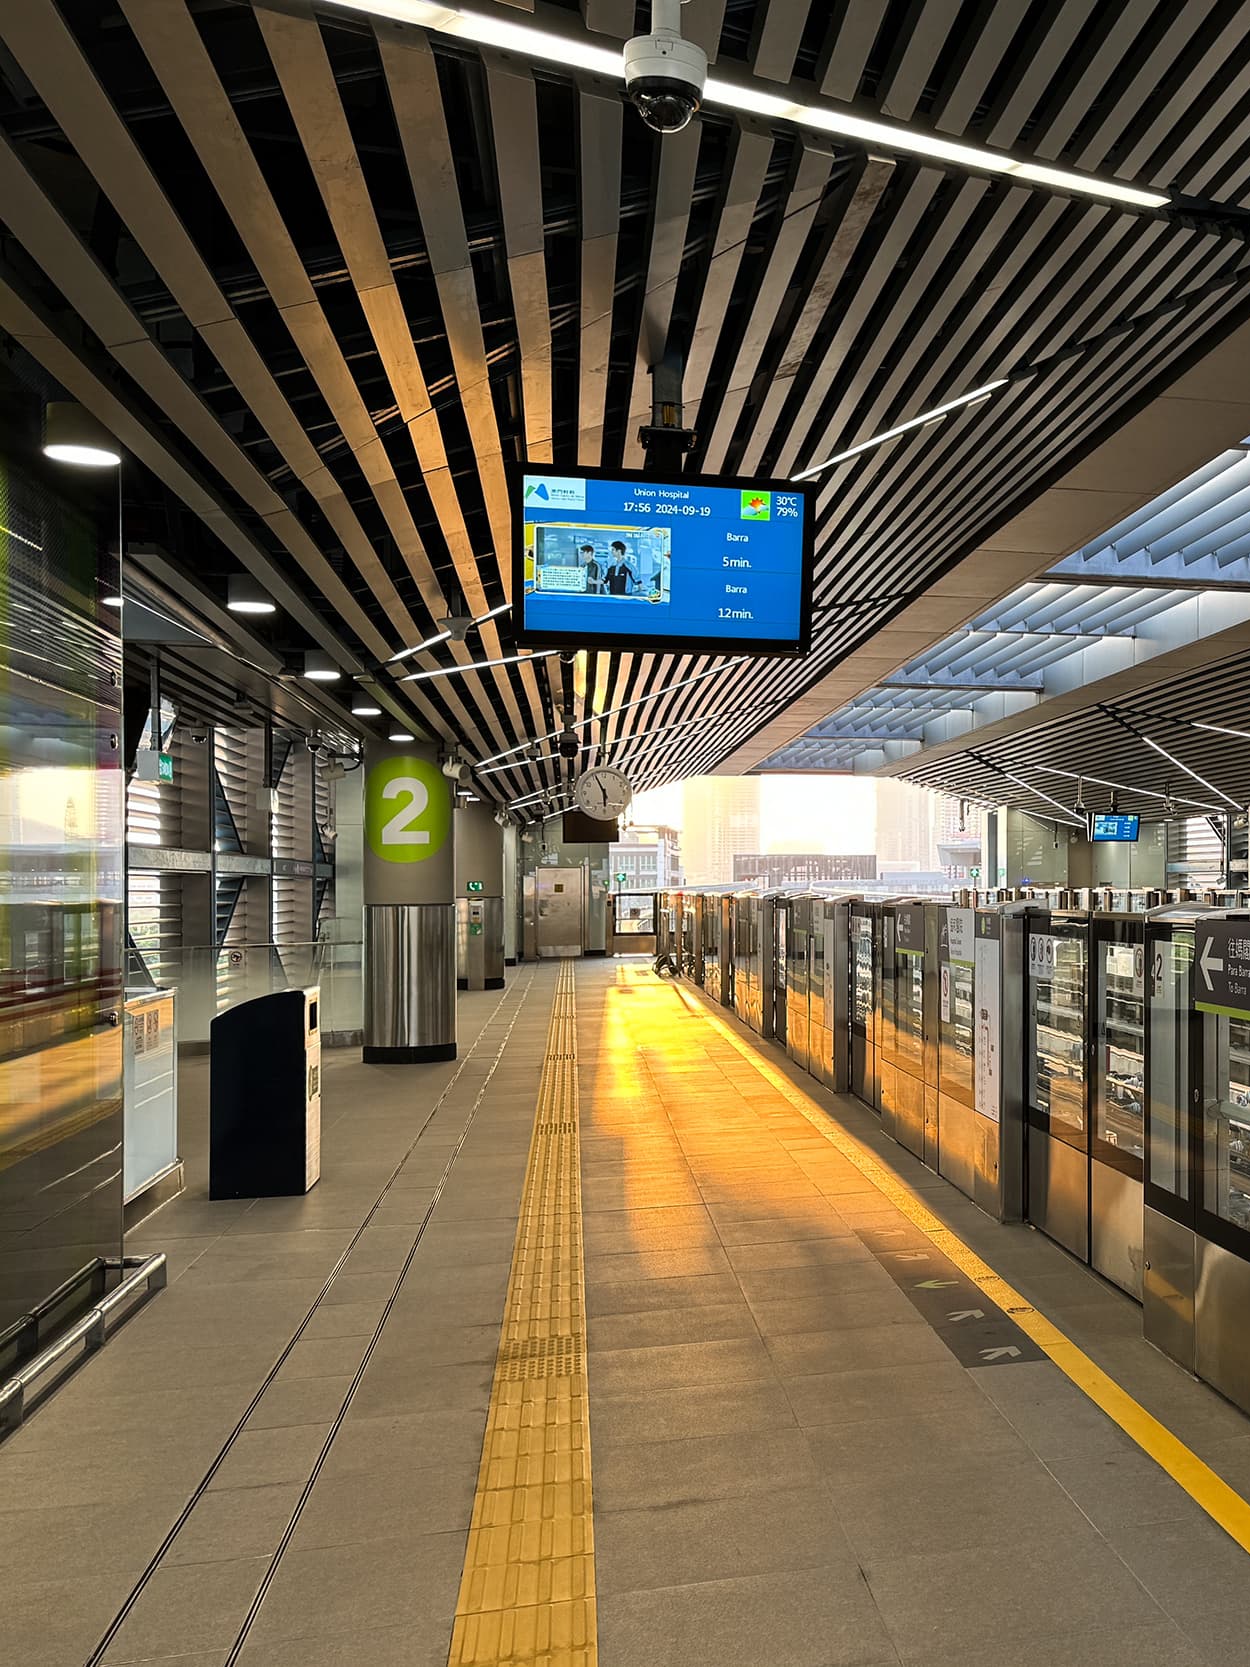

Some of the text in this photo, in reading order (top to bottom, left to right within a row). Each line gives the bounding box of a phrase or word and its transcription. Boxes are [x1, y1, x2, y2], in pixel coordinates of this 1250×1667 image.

[634, 488, 690, 499] Union Hospital
[776, 495, 797, 506] 30°C
[623, 502, 711, 517] 17:56 2024-09-19
[776, 507, 798, 518] 79%
[726, 532, 749, 542] Barra
[725, 584, 748, 594] Barra
[382, 776, 430, 844] 2
[1228, 963, 1250, 978] Para Barra
[1228, 981, 1247, 995] To Barra
